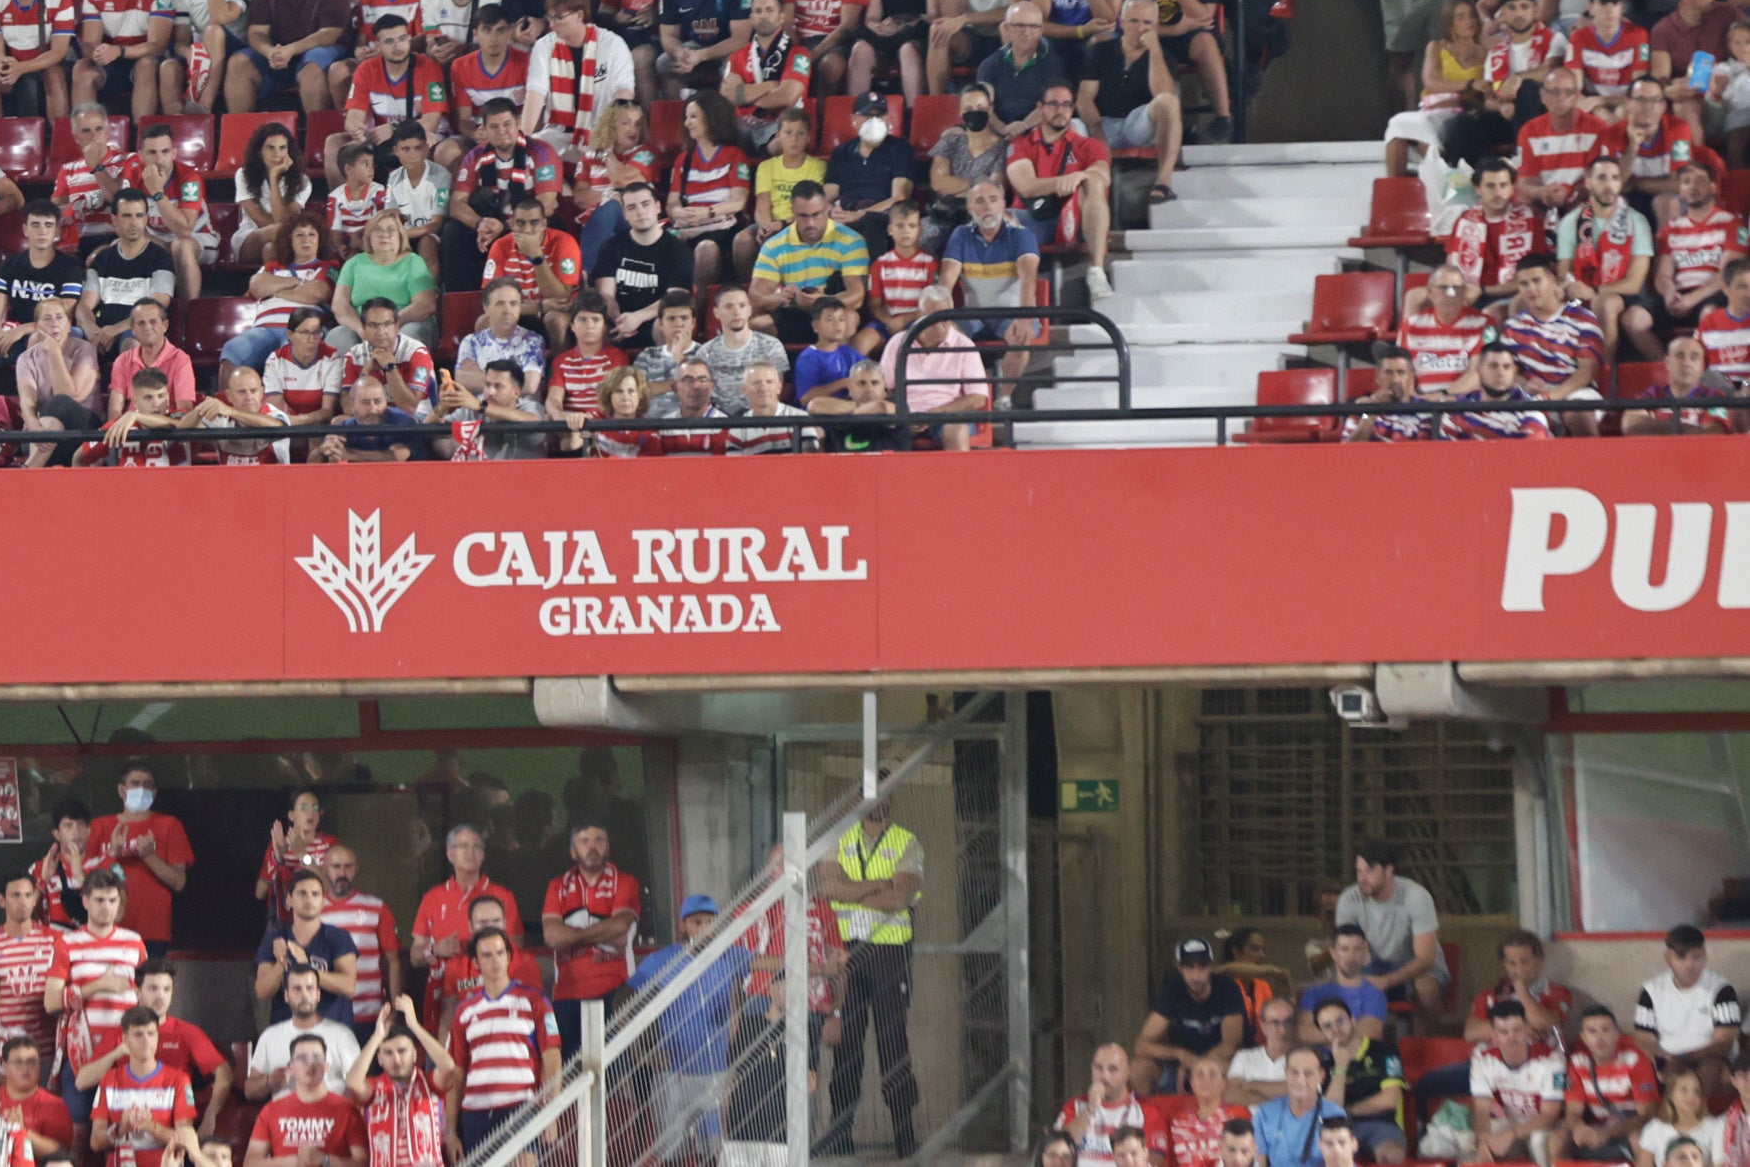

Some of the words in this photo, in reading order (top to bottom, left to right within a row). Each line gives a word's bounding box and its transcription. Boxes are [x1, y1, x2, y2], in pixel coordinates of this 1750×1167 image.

[453, 530, 616, 590] CAJA
[632, 525, 867, 585] RURAL
[538, 593, 781, 636] GRANADA
[278, 1117, 335, 1134] TOMMY
